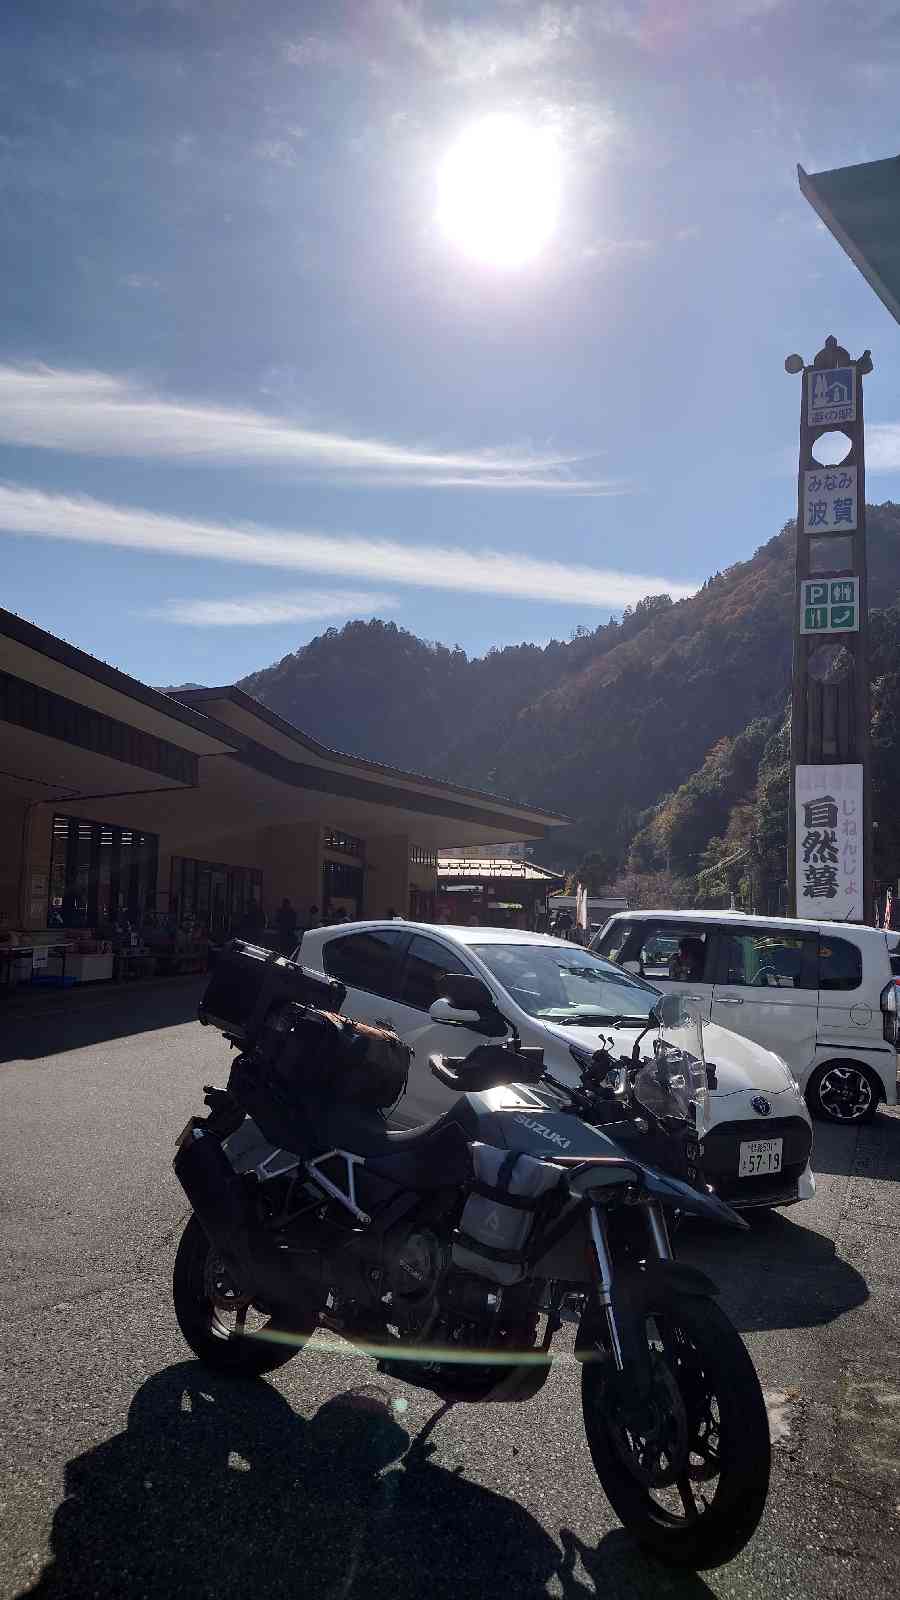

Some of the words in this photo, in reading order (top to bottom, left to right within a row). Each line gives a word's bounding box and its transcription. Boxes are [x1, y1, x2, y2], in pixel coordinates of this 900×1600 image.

[808, 472, 853, 492] みなみ
[808, 498, 853, 527] 波賀
[810, 586, 824, 604] P
[801, 795, 840, 899] 自然薯
[513, 1114, 571, 1149] SUZUKI
[749, 1153, 780, 1173] 57-19
